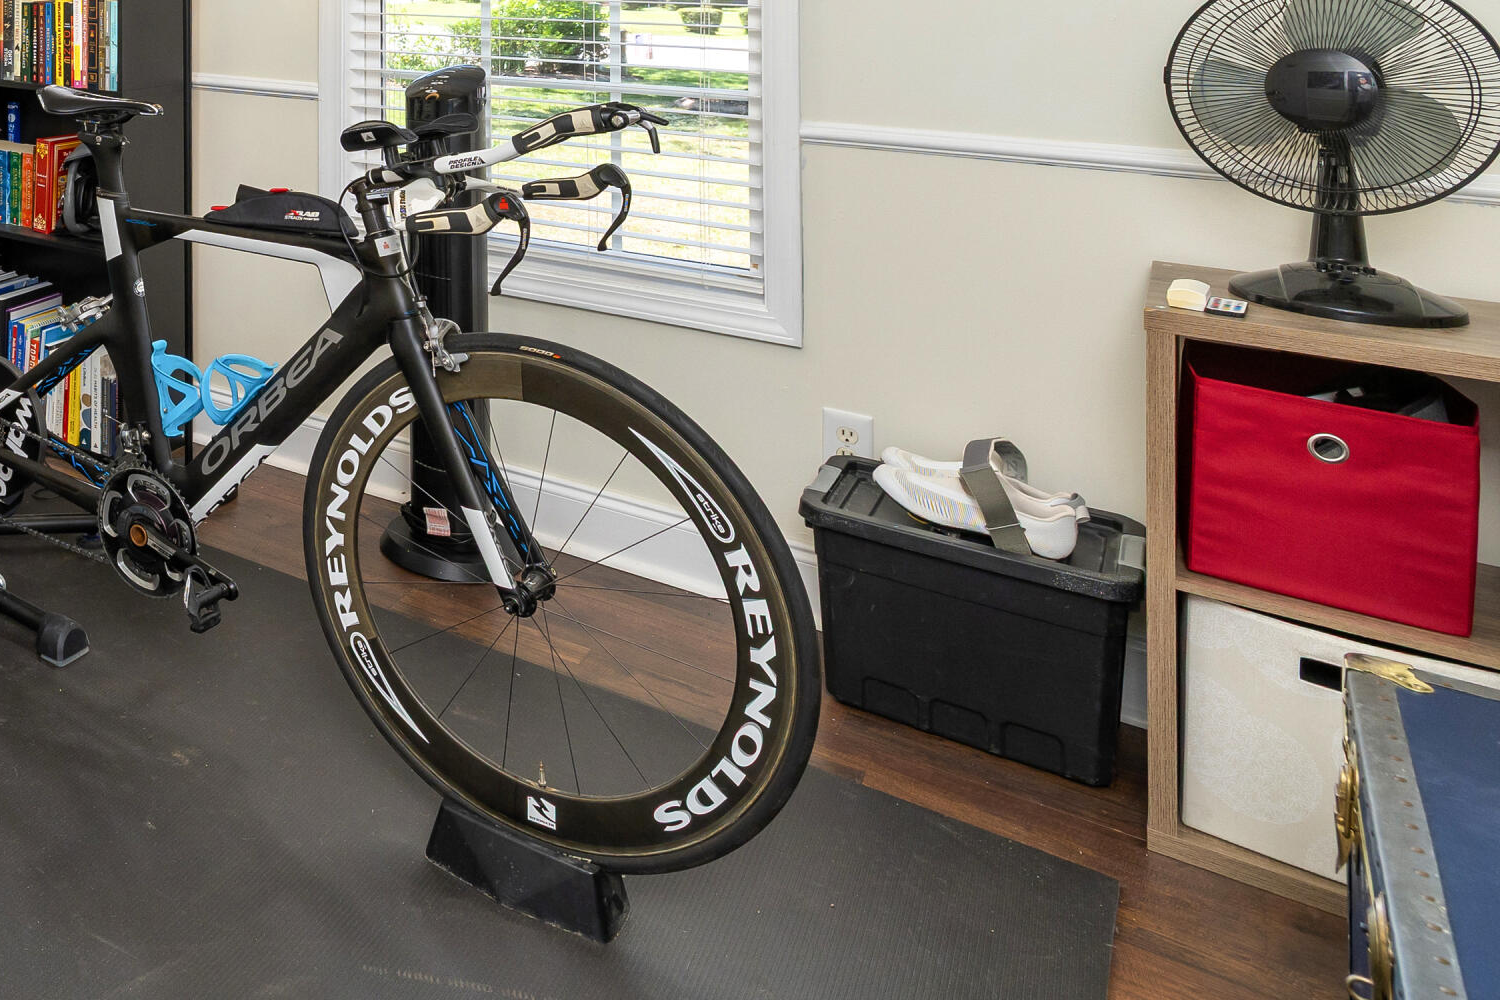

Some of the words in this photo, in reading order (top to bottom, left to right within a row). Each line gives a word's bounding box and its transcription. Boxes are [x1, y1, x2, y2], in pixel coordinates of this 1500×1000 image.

[448, 155, 478, 165] PROFILE
[450, 161, 477, 170] DESIGN
[201, 327, 344, 476] ORBEA
[325, 386, 417, 634] REYNOLDS
[653, 547, 778, 832] REYNOLDS
